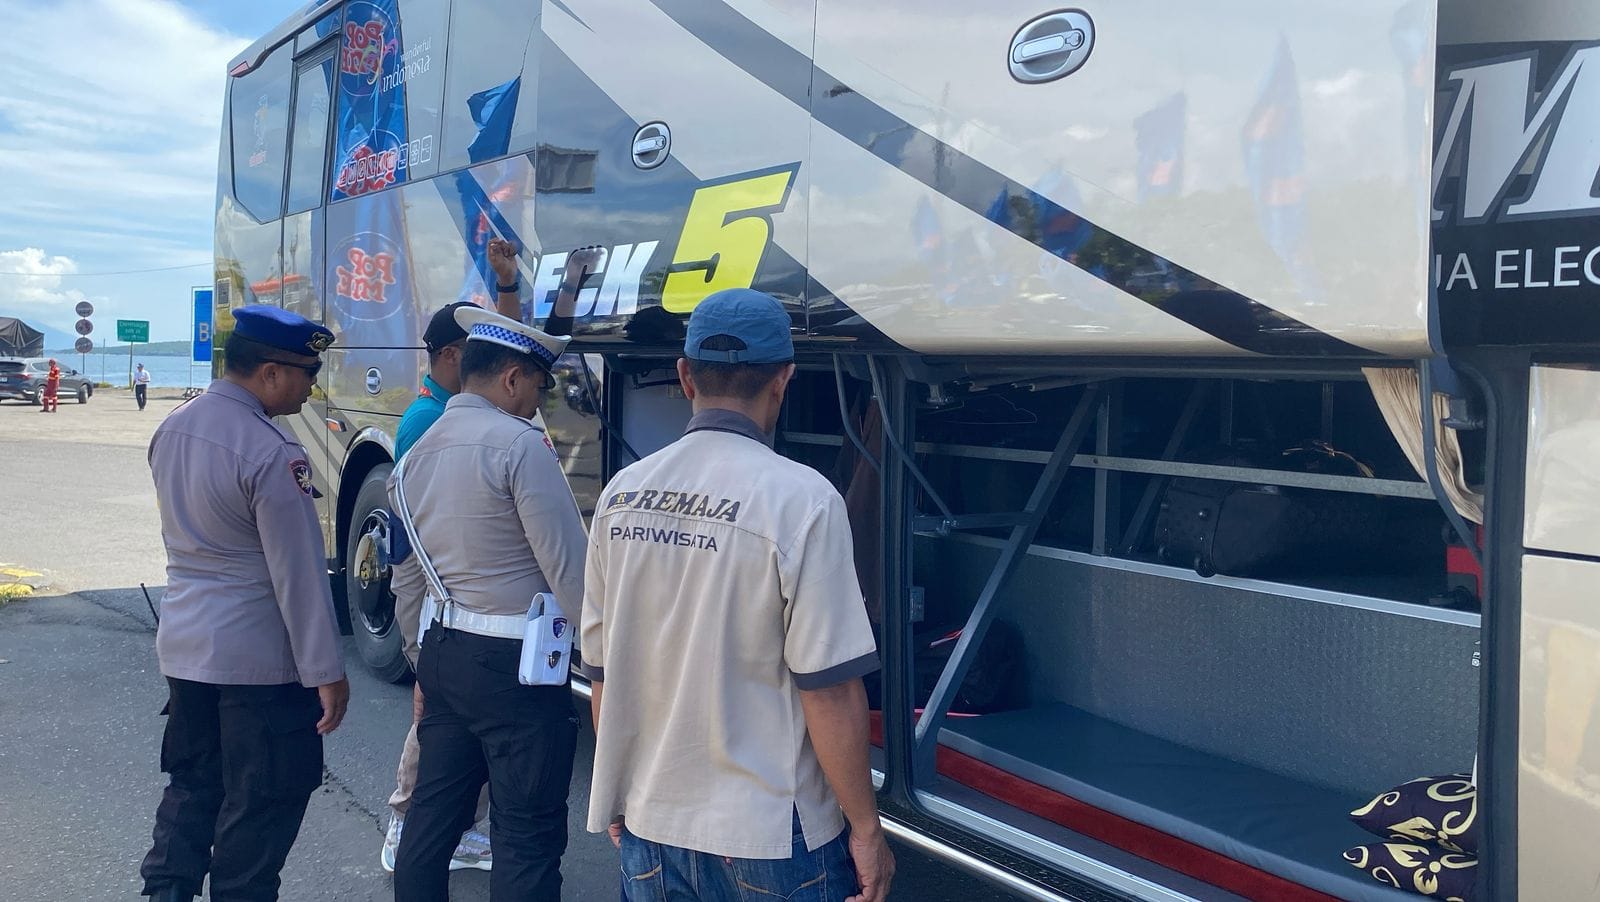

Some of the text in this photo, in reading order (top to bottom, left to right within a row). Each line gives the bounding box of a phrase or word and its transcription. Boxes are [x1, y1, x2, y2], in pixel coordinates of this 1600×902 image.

[533, 163, 799, 319] ECK 5
[633, 489, 741, 523] REMAJA
[610, 526, 718, 552] PARIWISATA
